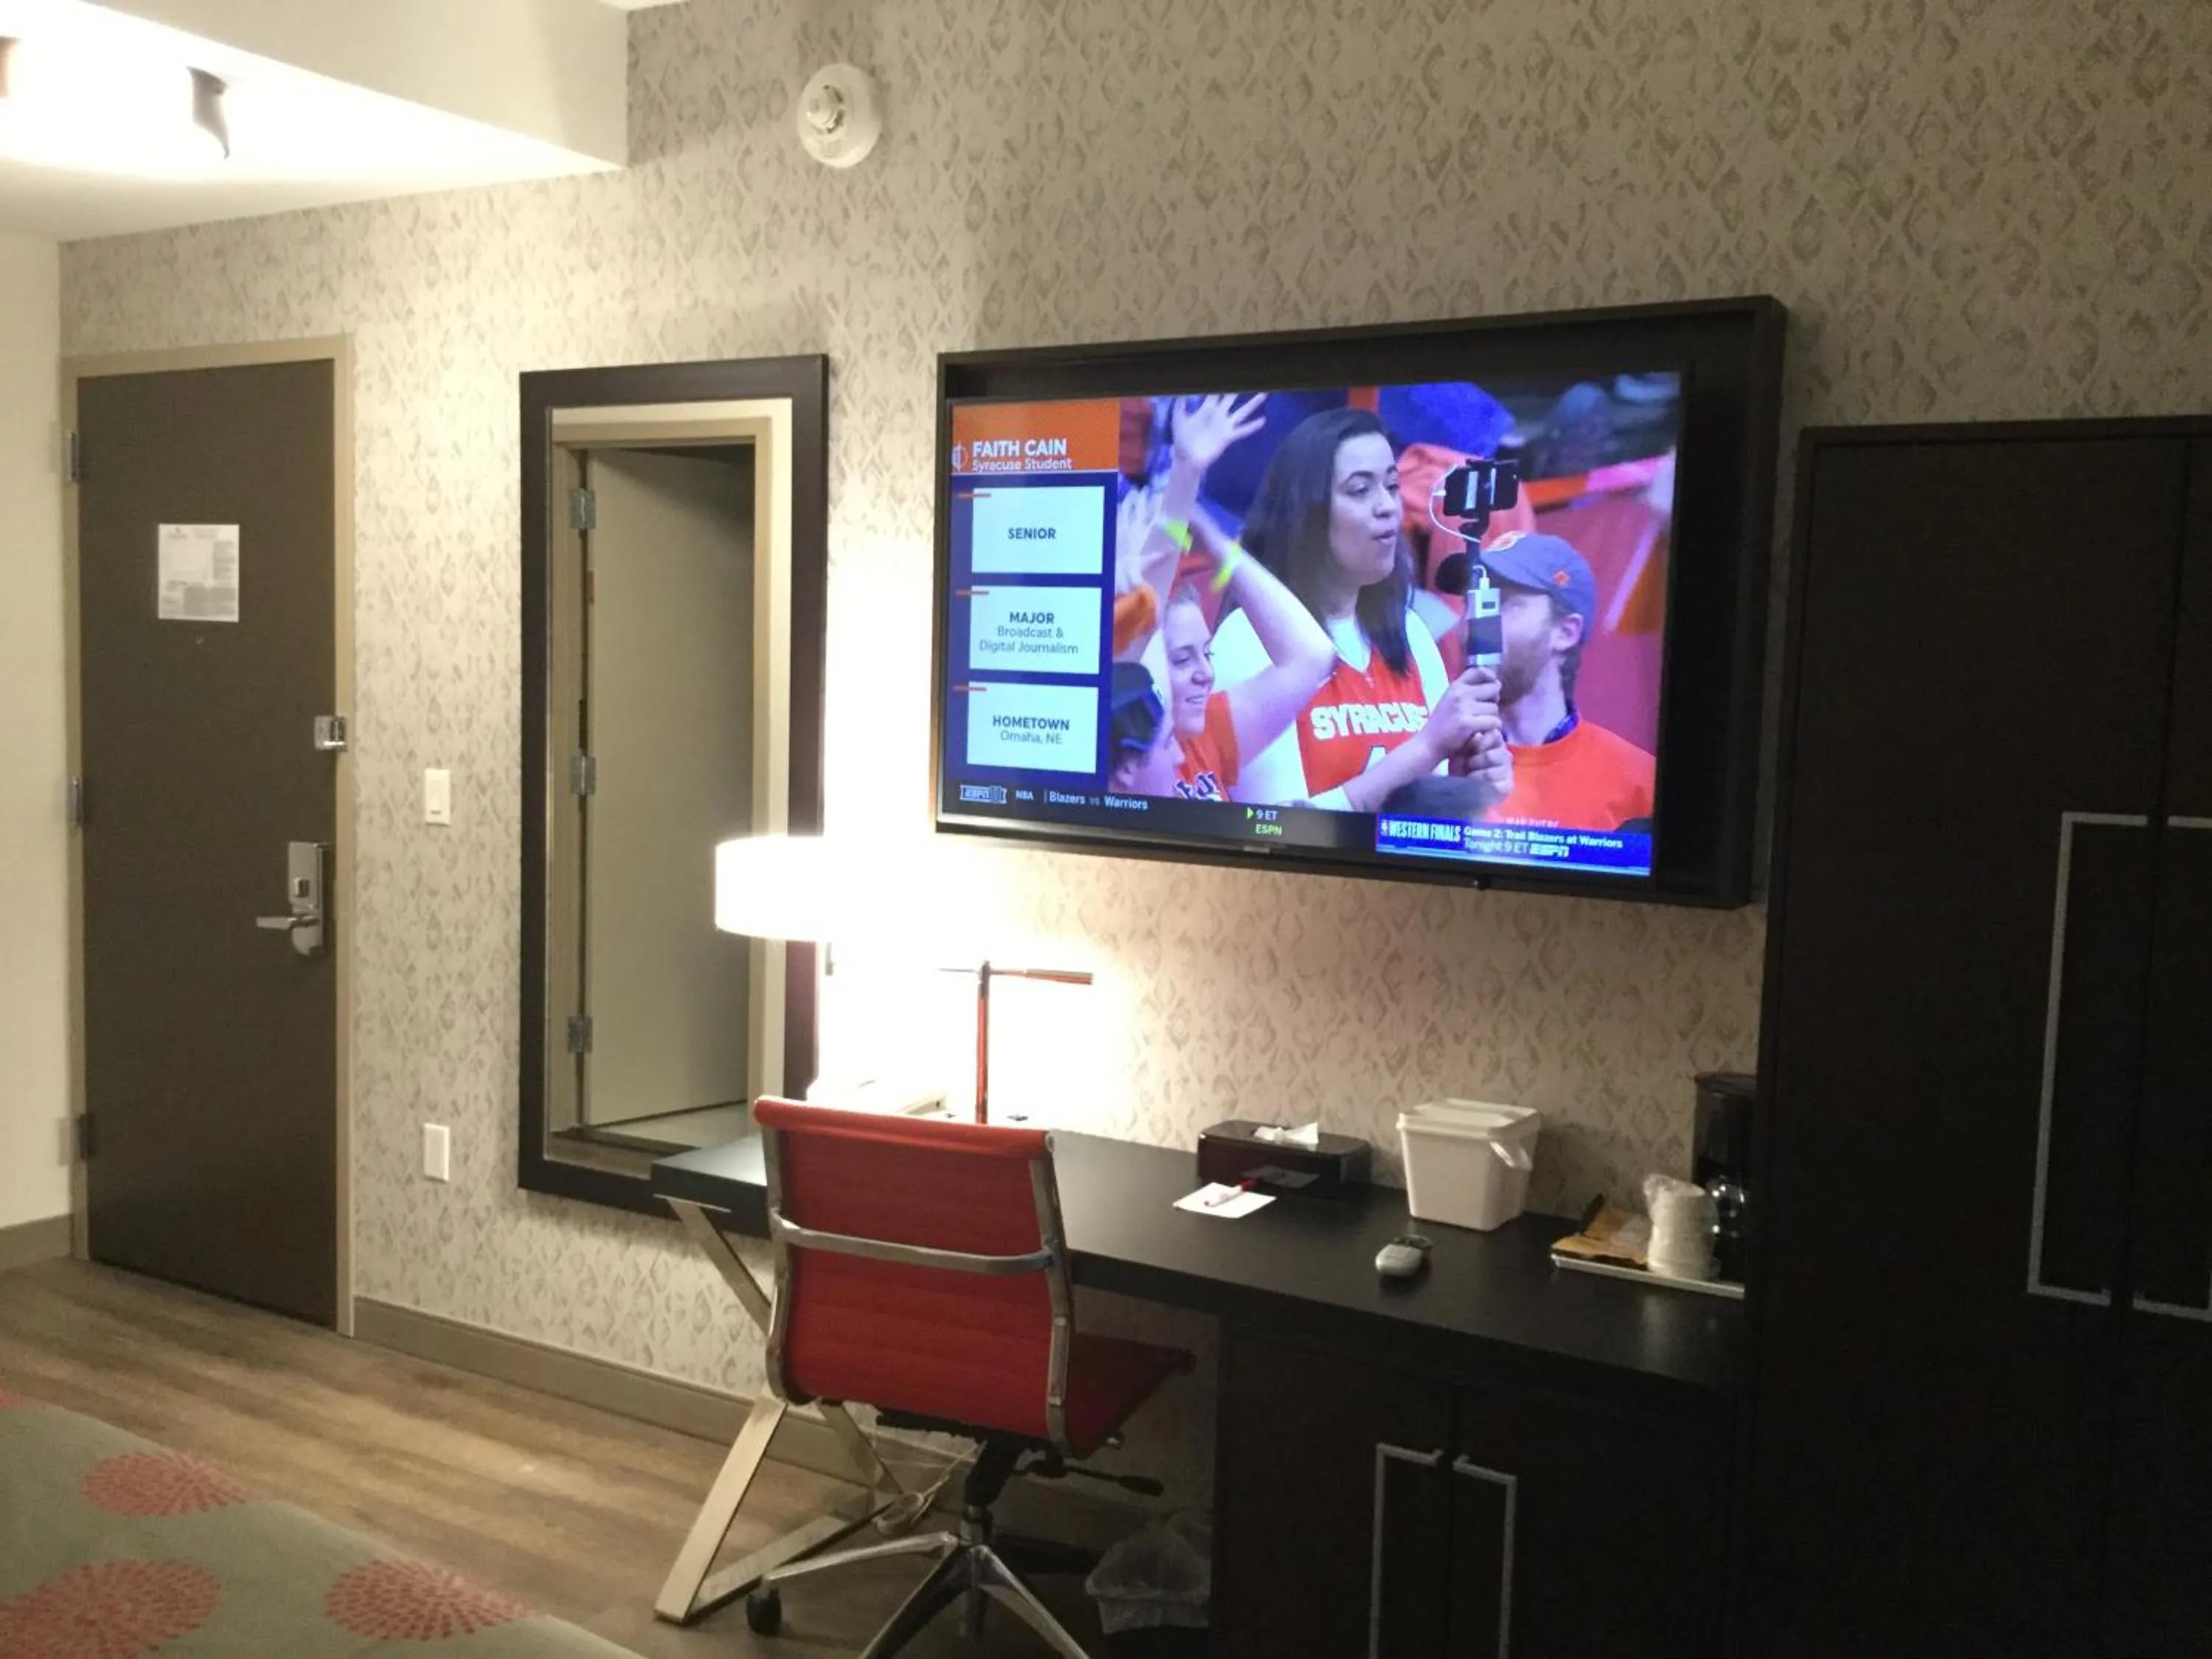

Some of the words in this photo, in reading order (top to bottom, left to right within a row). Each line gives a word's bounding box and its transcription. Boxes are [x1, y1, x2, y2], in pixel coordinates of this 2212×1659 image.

[972, 440, 1020, 458] FAITH
[1025, 439, 1068, 456] CAIN
[972, 459, 1022, 473] Syracuse
[1024, 457, 1072, 470] Student
[1007, 528, 1057, 540] SENIOR
[1009, 612, 1055, 624] MAJOR
[997, 626, 1053, 638] Broadcast
[1055, 627, 1064, 639] &
[979, 639, 1015, 653] Digital
[1018, 641, 1079, 654] Journalism
[993, 715, 1070, 730] HOMETOWN
[1000, 731, 1043, 745] Omaha,
[1046, 733, 1062, 744] NE
[1049, 790, 1086, 804] Blazers
[1104, 796, 1148, 810] Warriors
[1256, 810, 1263, 820] 9
[1265, 810, 1278, 821] ET
[1255, 824, 1282, 835] ESPN
[1389, 820, 1429, 839] WESTERN
[1430, 824, 1461, 842] FINALS
[1528, 832, 1565, 844] Blazers
[1579, 835, 1623, 848] Warriors
